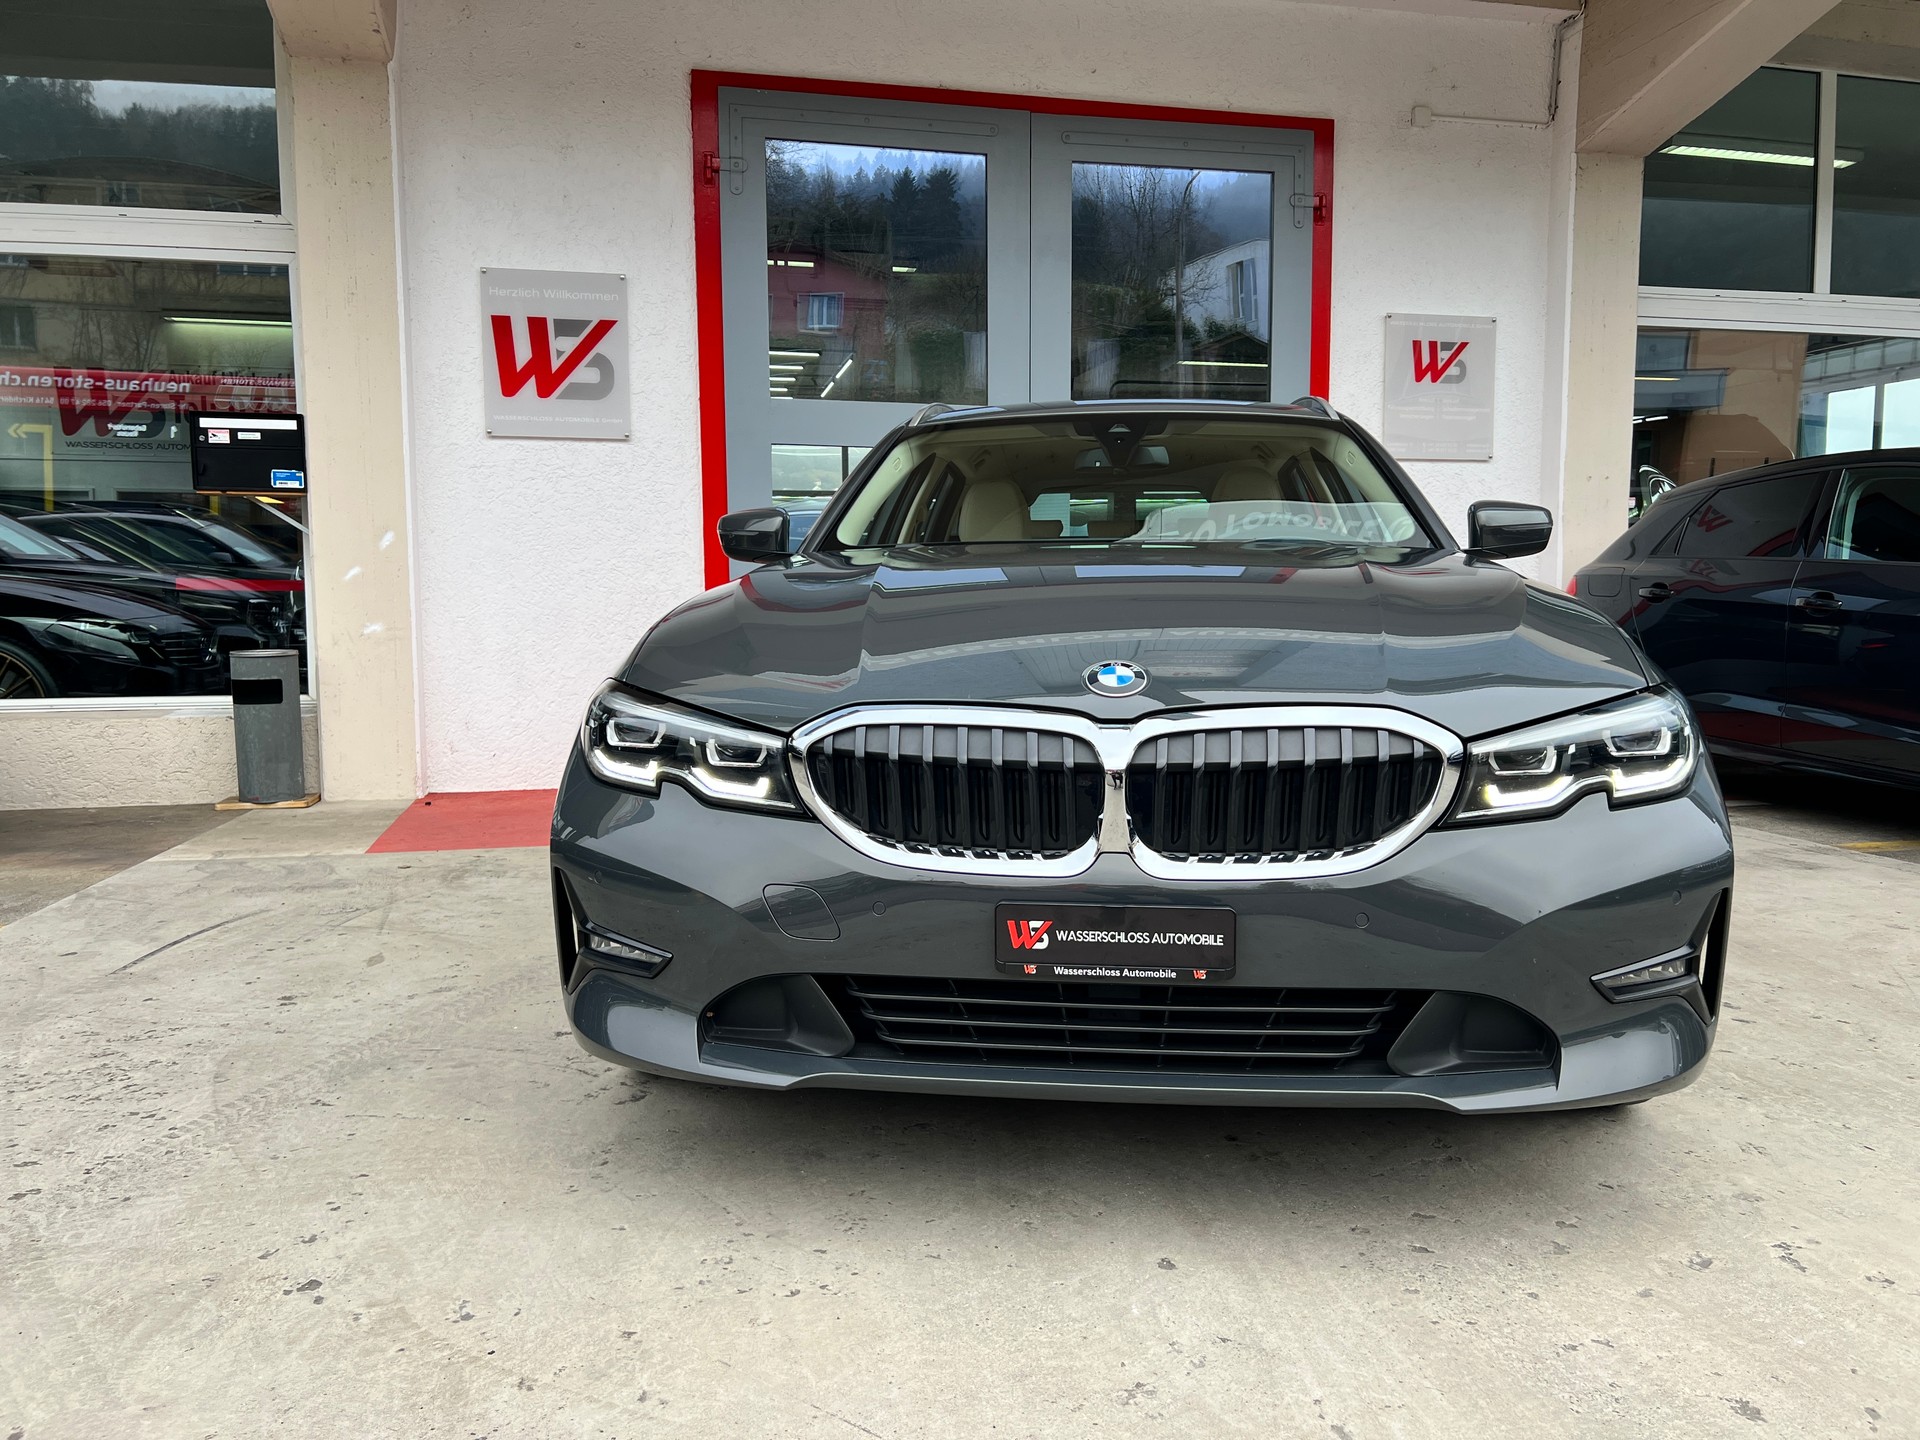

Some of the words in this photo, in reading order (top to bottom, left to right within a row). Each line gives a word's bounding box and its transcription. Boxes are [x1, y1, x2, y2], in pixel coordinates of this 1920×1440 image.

[489, 286, 540, 298] Herzlich
[543, 288, 619, 301] Willkommen
[493, 414, 553, 423] WASSERSCHLOSS
[554, 416, 600, 424] AUTOMOBILE
[66, 440, 153, 450] WASSERSCHLOSS
[1056, 929, 1150, 944] WASSERSCHLOSS
[1151, 932, 1224, 946] AUTOMOBILE
[1053, 966, 1121, 977] Wasserschloss
[1122, 968, 1177, 979] Automobile
